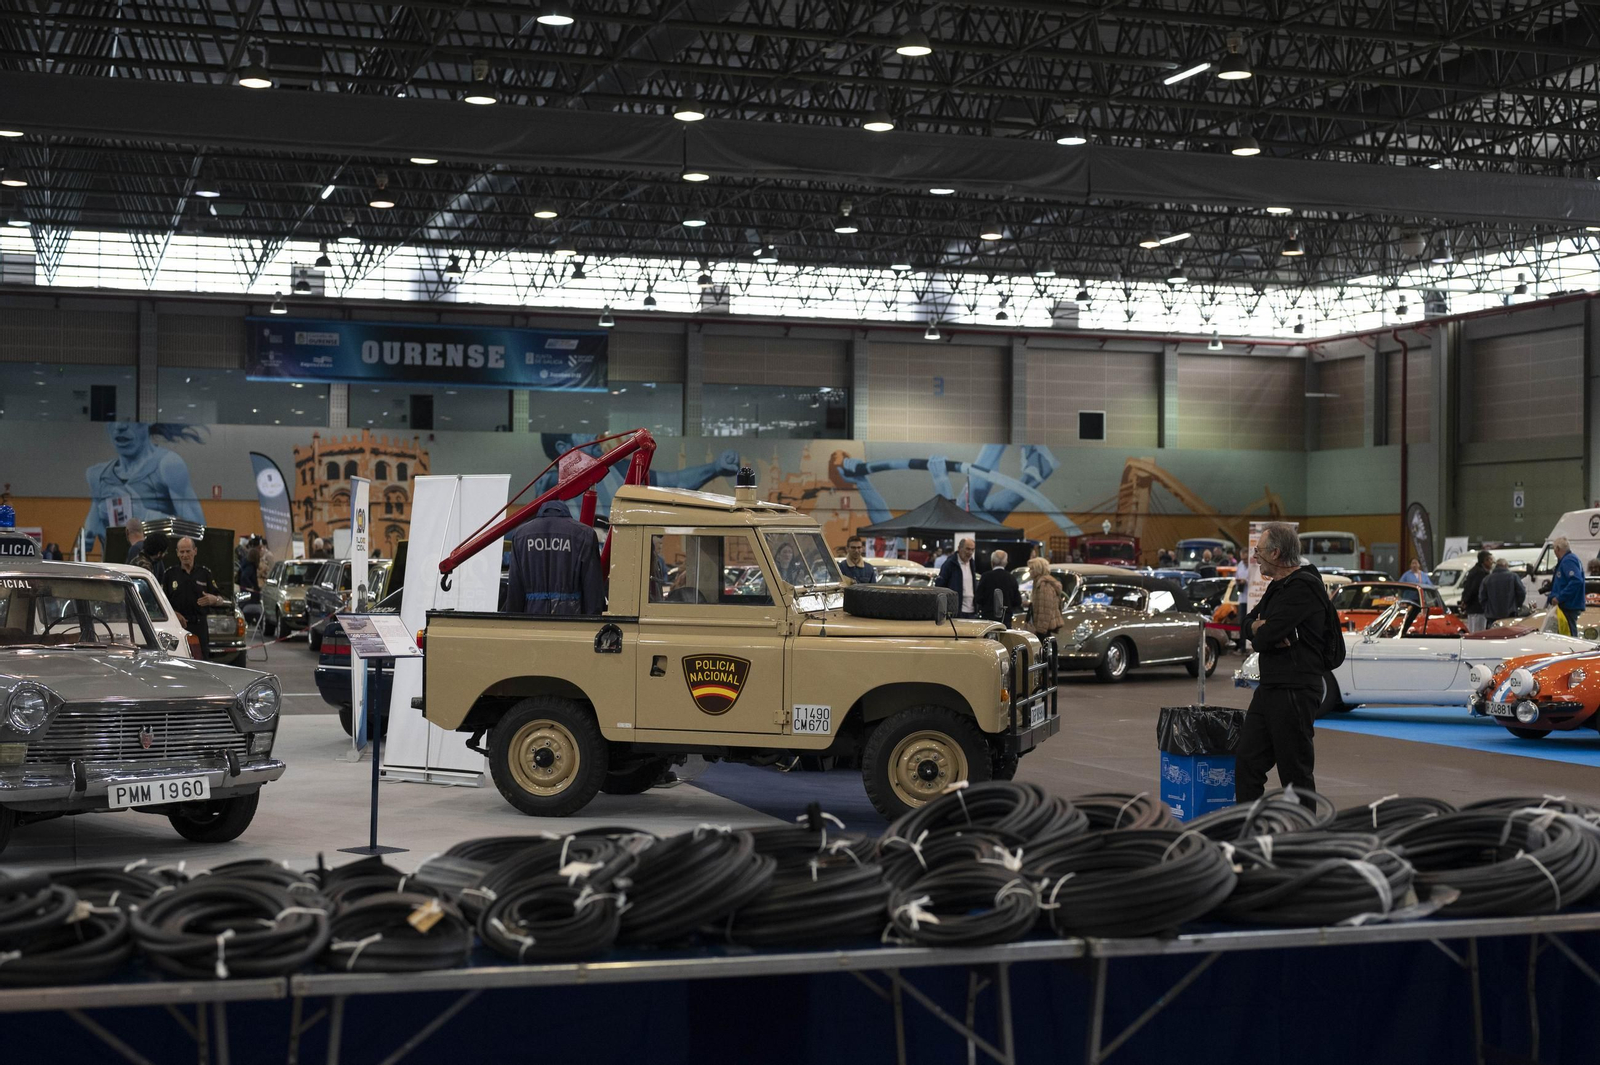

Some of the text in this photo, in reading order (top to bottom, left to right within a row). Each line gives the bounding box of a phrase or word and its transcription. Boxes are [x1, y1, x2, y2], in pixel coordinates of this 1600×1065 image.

[361, 340, 506, 369] OURENSE
[527, 537, 571, 552] POLCIA
[695, 659, 736, 673] POLICIA
[689, 671, 740, 686] NACIONAL
[116, 780, 203, 804] PMM 1960
